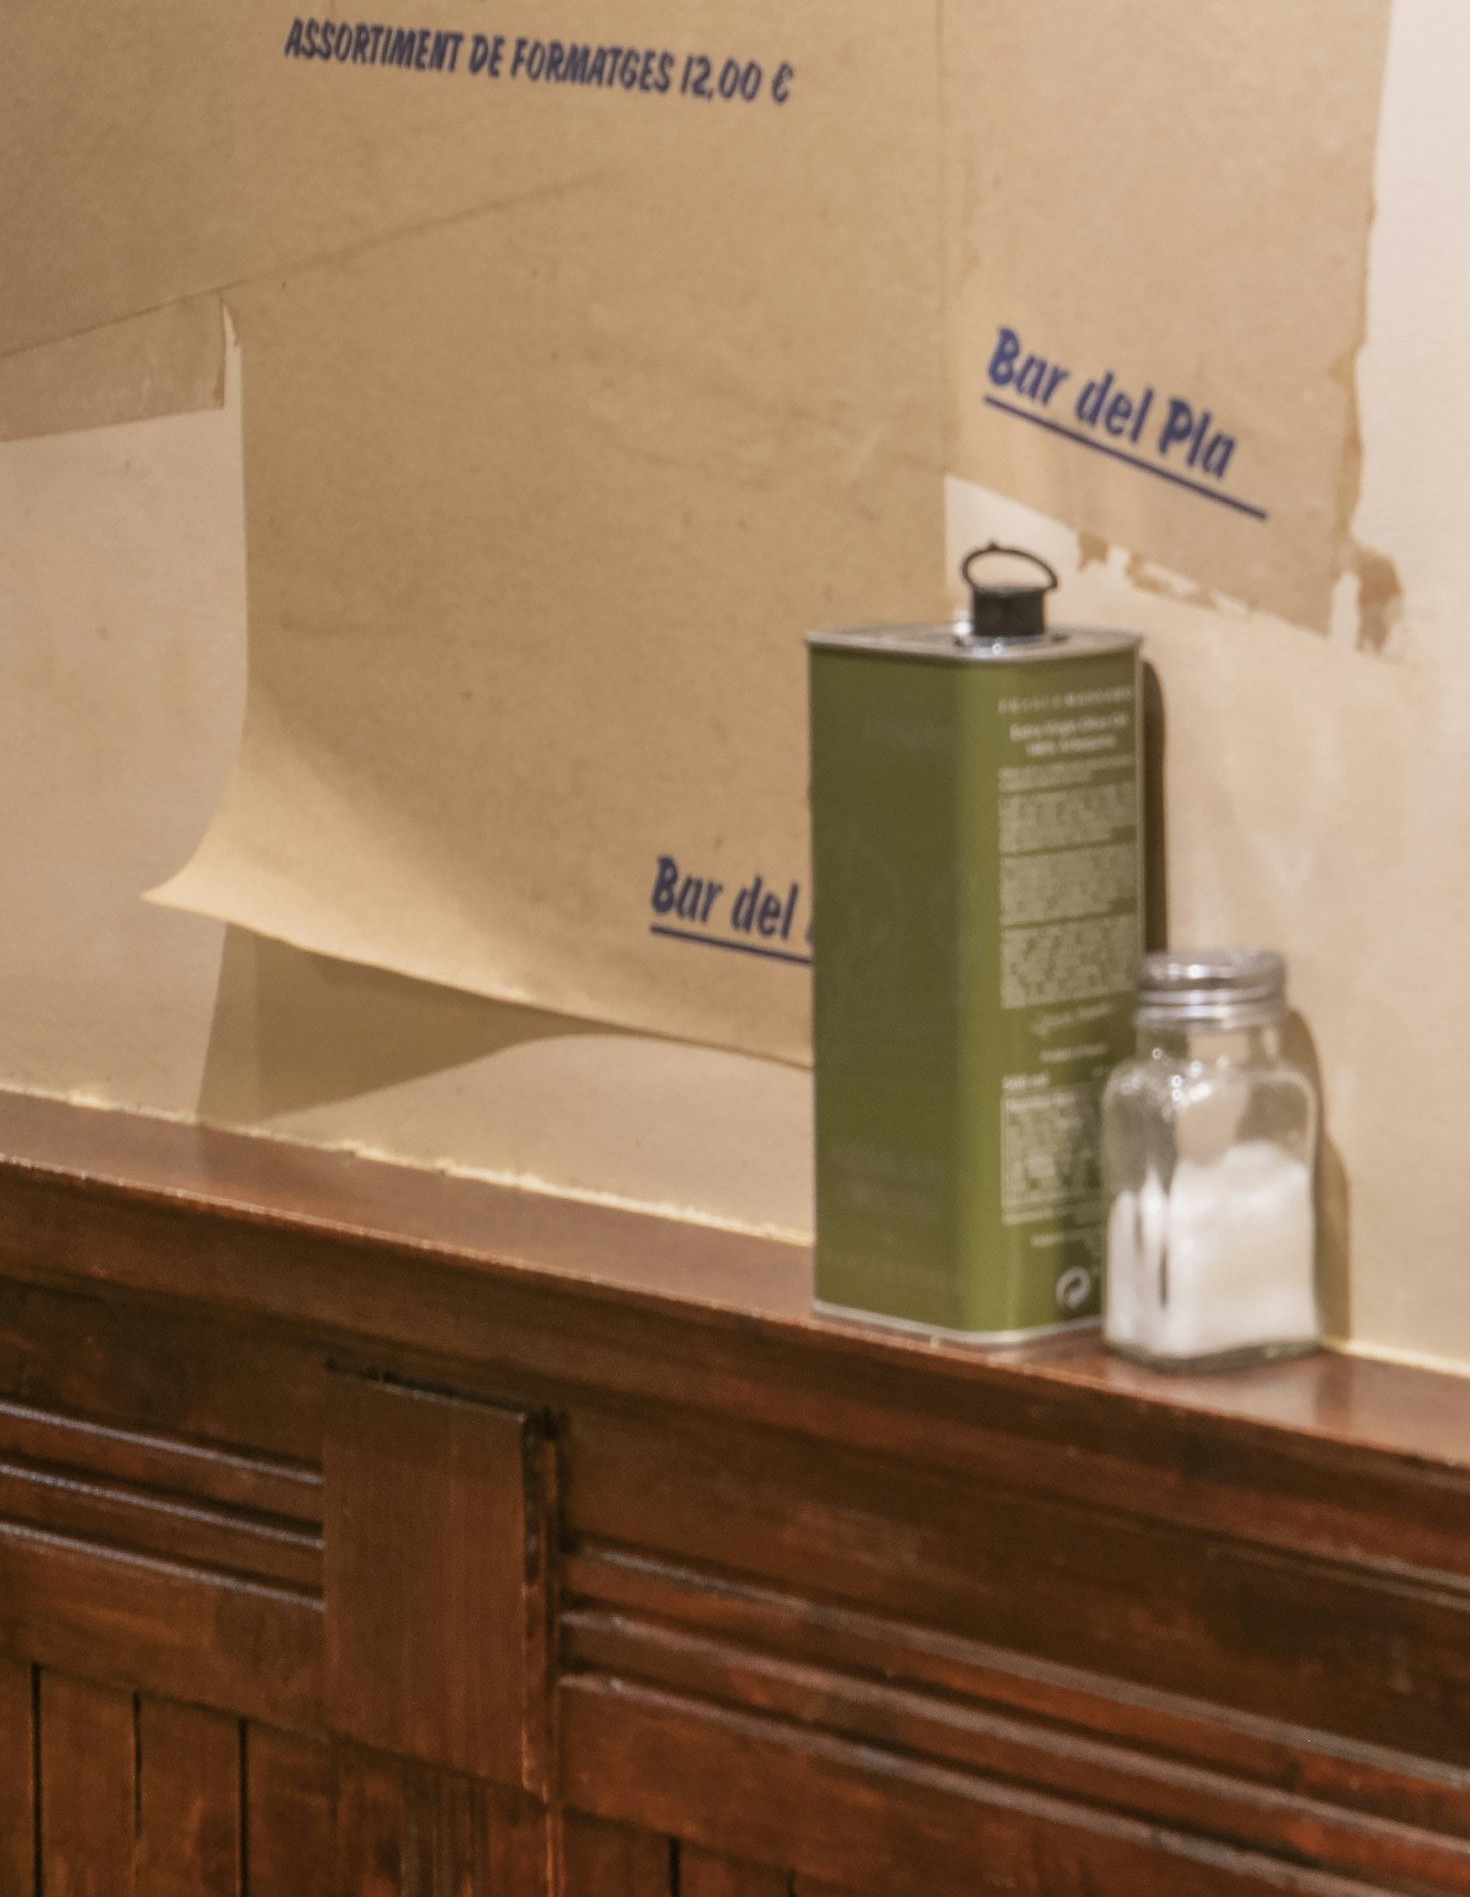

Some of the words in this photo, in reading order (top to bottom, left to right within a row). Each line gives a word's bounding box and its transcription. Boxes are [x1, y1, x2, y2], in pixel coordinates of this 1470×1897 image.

[284, 19, 463, 73] ASSORTIMENT
[469, 34, 505, 80] DE
[511, 39, 674, 94] FORMATGES
[771, 63, 794, 105] €
[986, 327, 1069, 410] Bar
[1077, 370, 1155, 445] del
[1160, 396, 1236, 481] Pla
